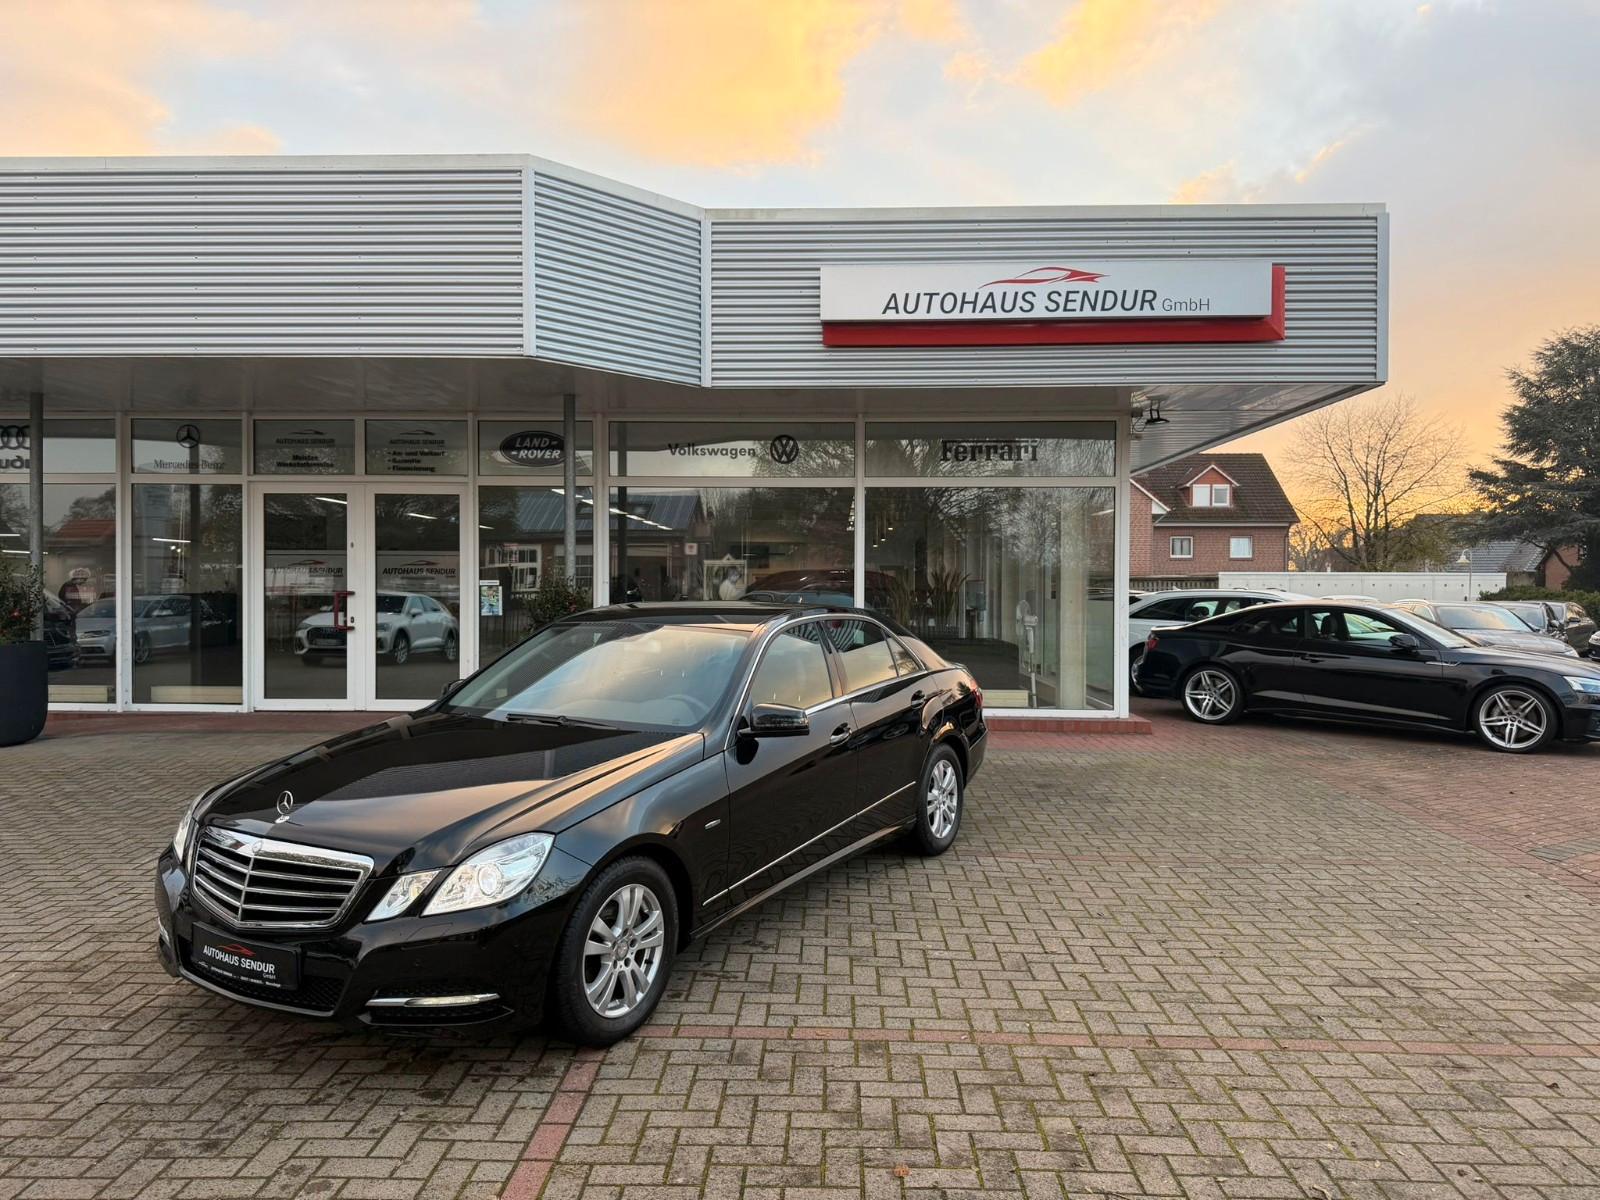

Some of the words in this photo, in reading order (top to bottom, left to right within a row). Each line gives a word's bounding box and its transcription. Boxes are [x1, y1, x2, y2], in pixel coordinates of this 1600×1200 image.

[882, 290, 1036, 315] AUTOHAUS
[1045, 289, 1157, 313] SENDUR
[1162, 298, 1210, 312] GmbH
[668, 443, 756, 459] Volkswagen
[940, 439, 1038, 462] Ferrari
[382, 567, 424, 575] AUTOHAUS
[203, 945, 239, 966] AUTOHAUS
[241, 958, 275, 974] SENDUR
